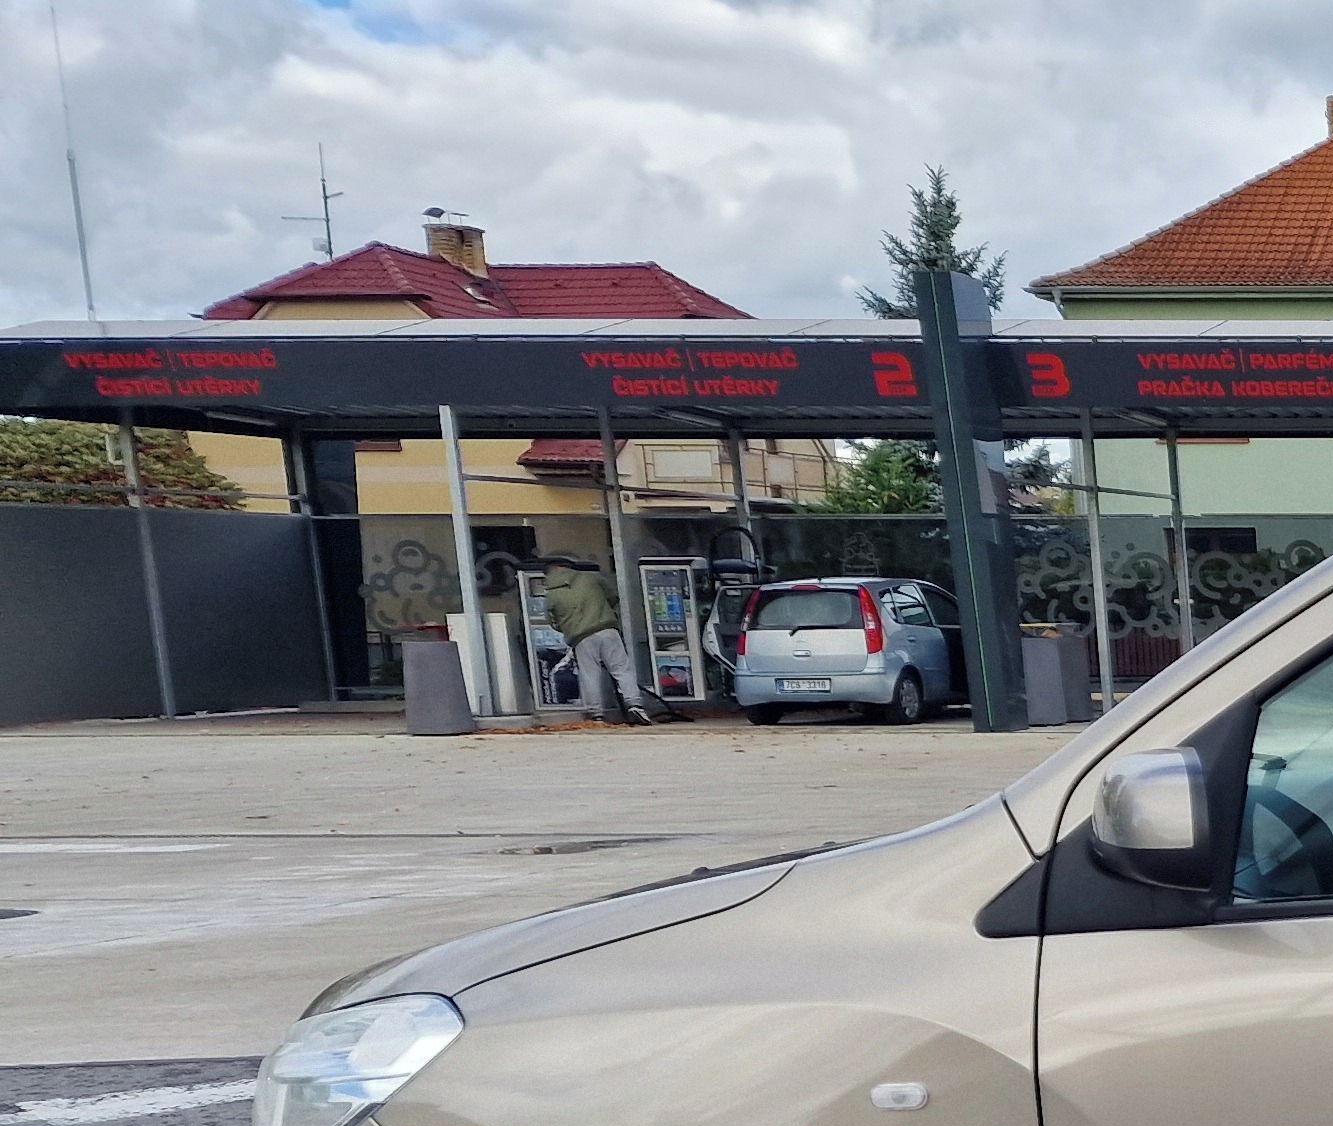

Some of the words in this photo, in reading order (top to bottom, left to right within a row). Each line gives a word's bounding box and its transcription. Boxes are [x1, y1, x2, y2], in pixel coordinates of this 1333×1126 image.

[581, 347, 683, 369] VYSAVAČ
[697, 347, 799, 369] TEPOVAČ
[1137, 348, 1236, 370] VYSAVAČ
[871, 352, 919, 396] 2
[1025, 353, 1071, 397] 3
[694, 375, 779, 396] UTĚRKY
[1137, 375, 1226, 396] PRAČKA
